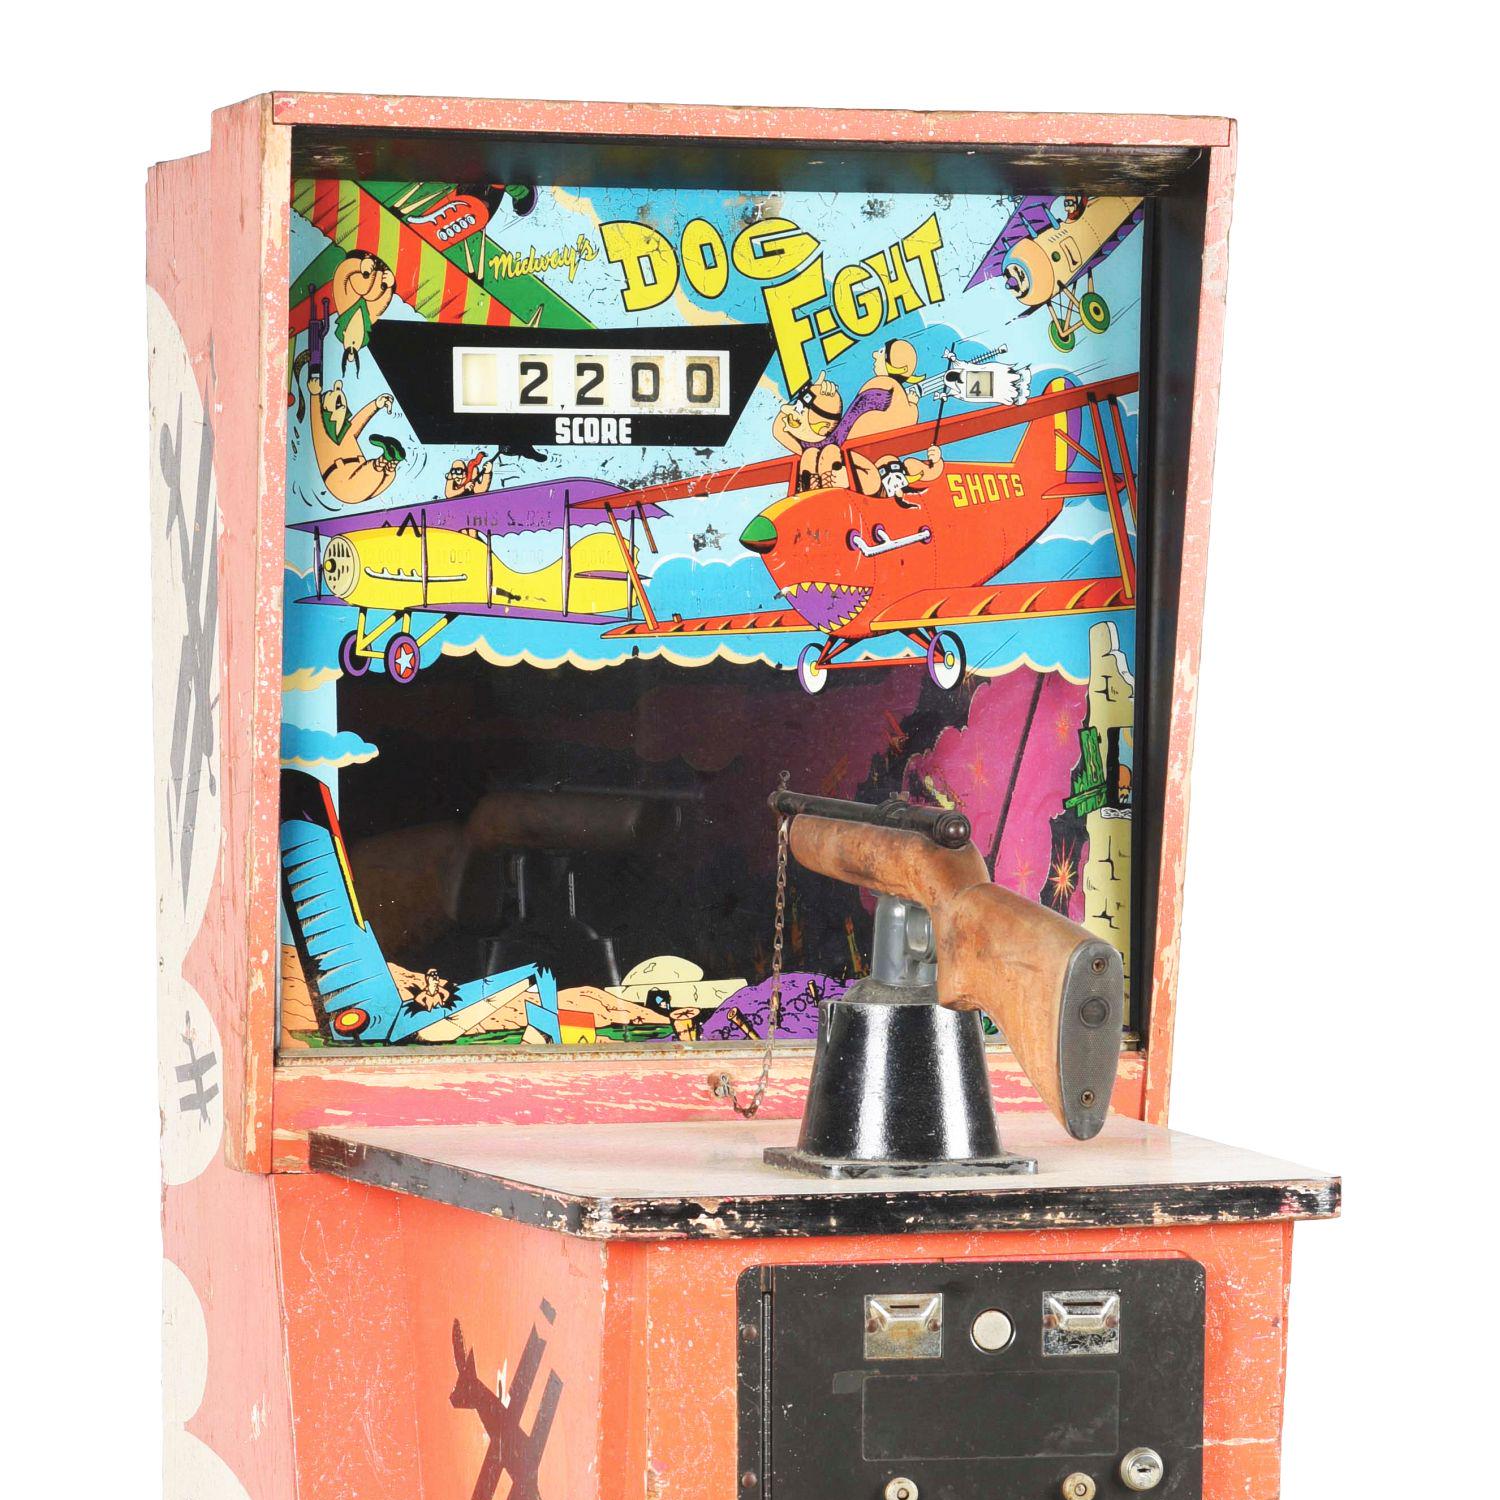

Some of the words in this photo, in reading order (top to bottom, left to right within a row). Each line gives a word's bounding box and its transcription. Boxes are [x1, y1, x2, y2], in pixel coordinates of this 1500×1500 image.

[489, 234, 599, 284] Midway's
[600, 217, 822, 312] DOG
[762, 213, 945, 399] FIGHT
[519, 360, 715, 406] 2200
[968, 379, 983, 397] 4
[555, 416, 632, 446] SCORE
[946, 471, 1025, 508] SHOTS
